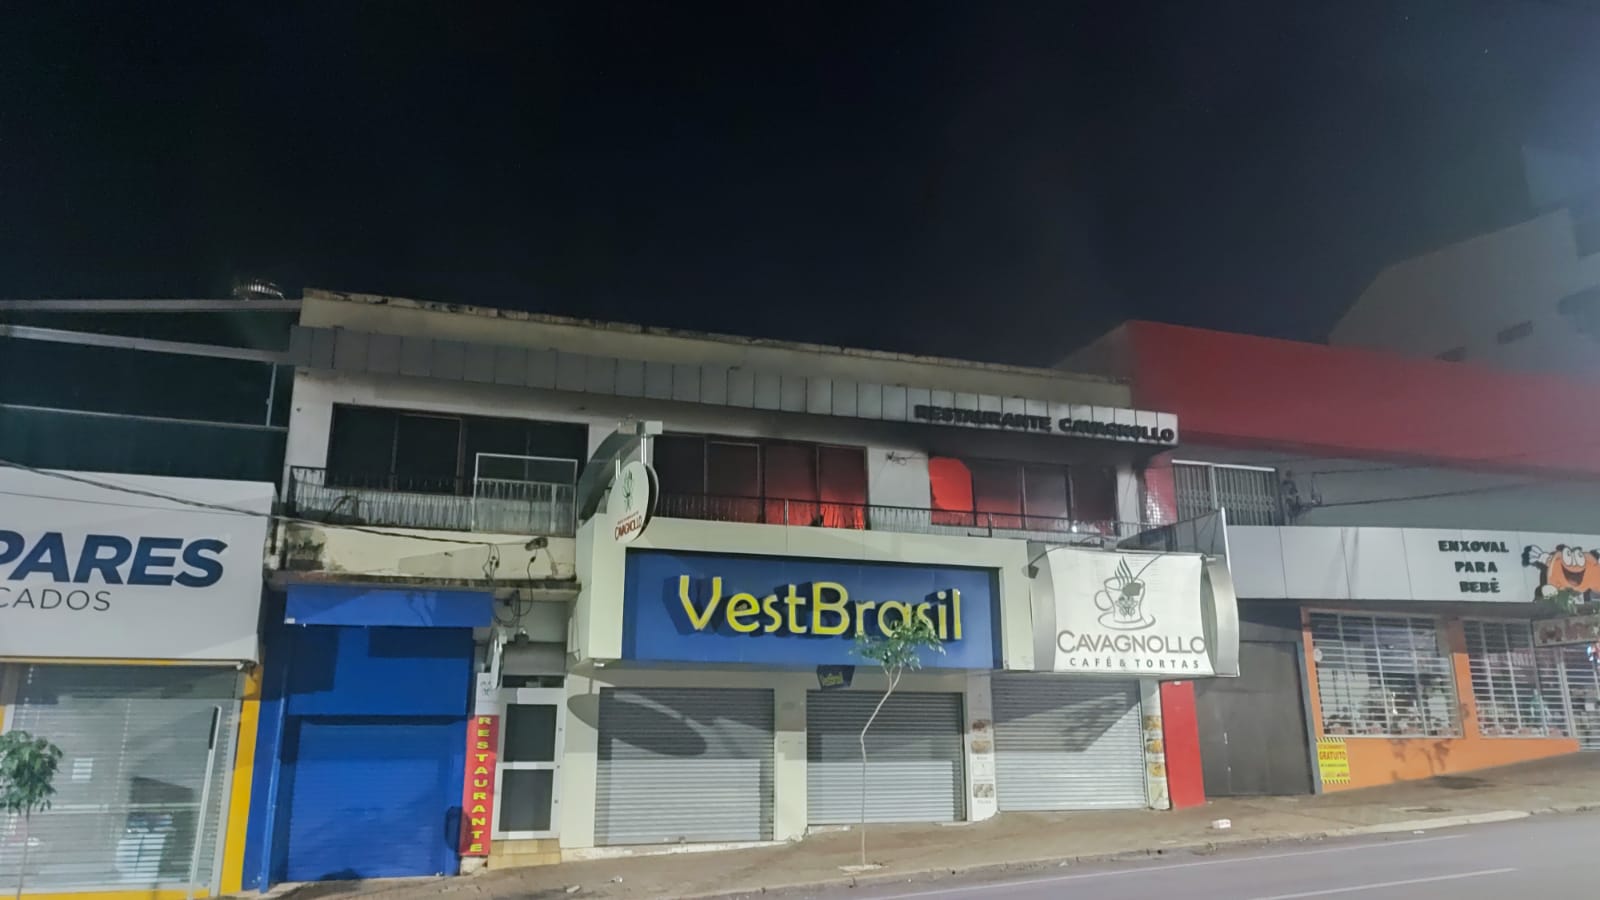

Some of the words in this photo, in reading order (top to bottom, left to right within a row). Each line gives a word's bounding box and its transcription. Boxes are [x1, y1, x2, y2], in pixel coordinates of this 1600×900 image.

[914, 405, 1051, 433] RESTAURANTE
[1058, 418, 1174, 442] CAVAGNOLLO
[1438, 540, 1509, 553] ENXOVAL
[1454, 561, 1498, 573] PARA
[1459, 577, 1500, 593] BEBÊ
[679, 575, 962, 640] VestBrasil
[1057, 630, 1206, 654] CAVAGNOLLO
[1070, 656, 1112, 668] CAFÉ
[1119, 659, 1127, 668] &
[1135, 659, 1199, 669] TORTAS
[469, 716, 492, 852] RESTAURANTE
